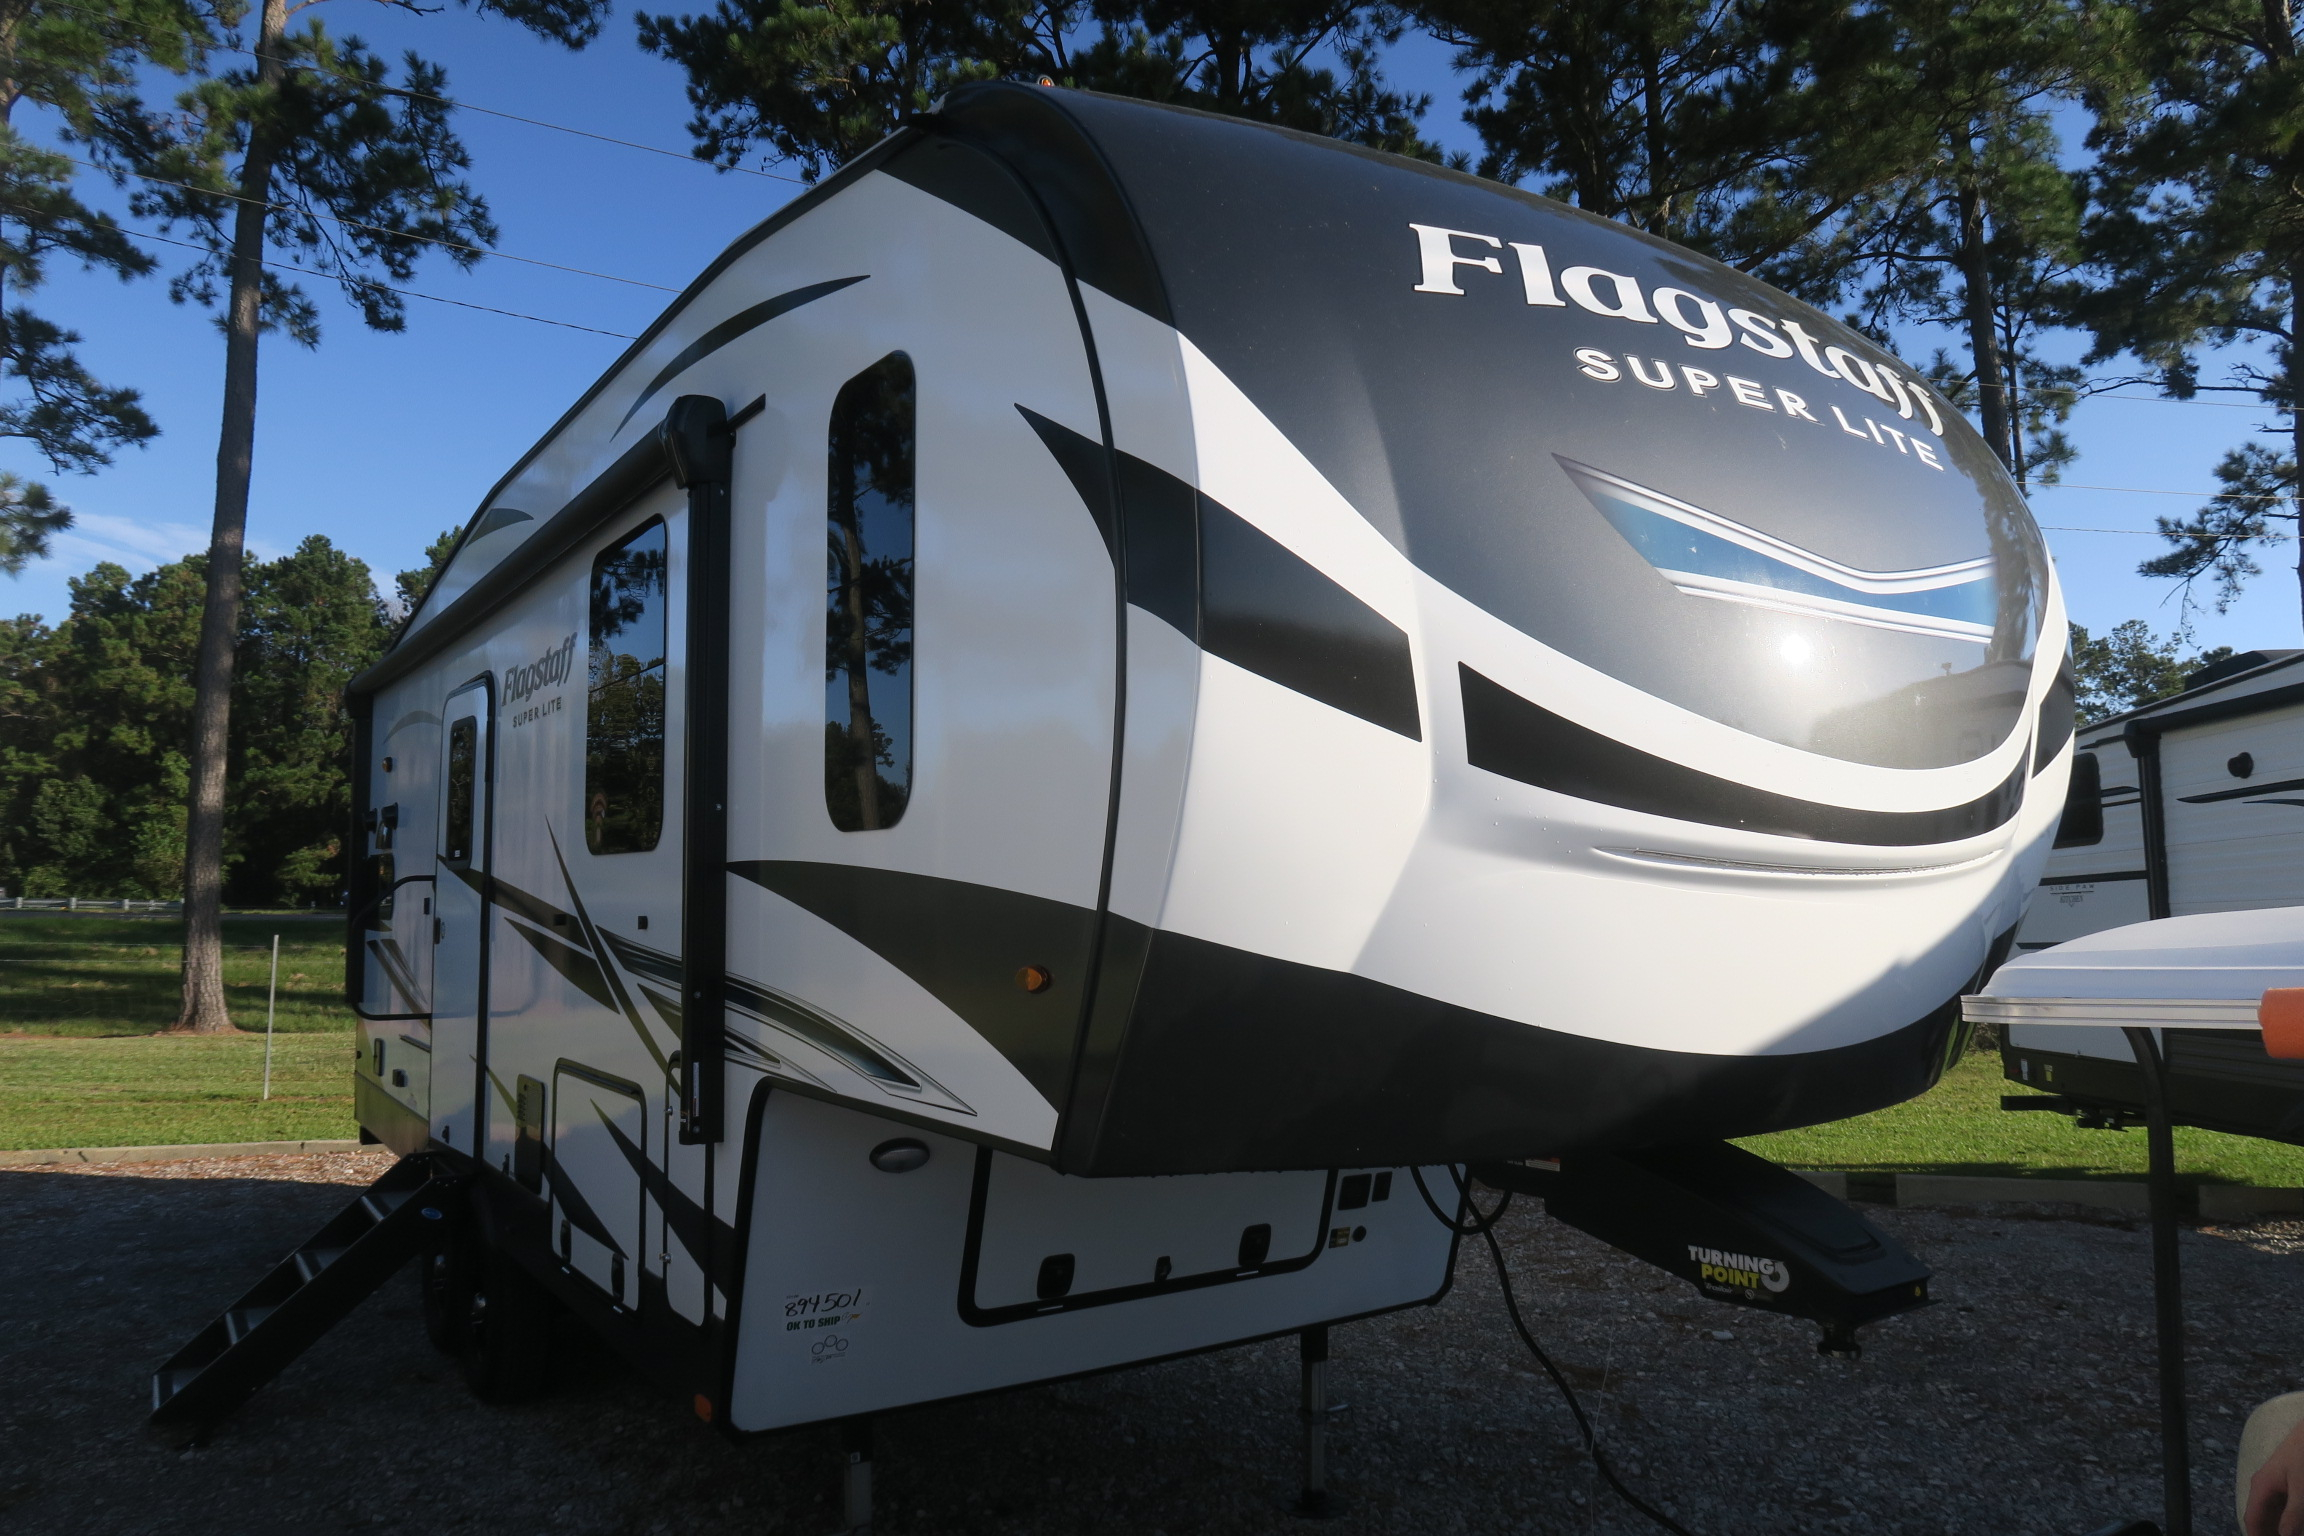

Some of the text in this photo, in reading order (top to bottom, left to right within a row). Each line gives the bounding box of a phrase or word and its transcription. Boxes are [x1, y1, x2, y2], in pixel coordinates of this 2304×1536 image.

[1408, 222, 1945, 437] Flagstaff
[1573, 347, 1945, 472] SUPER LITE
[501, 631, 578, 707] Flagstaff
[512, 696, 562, 729] SUPER LITE
[1687, 1244, 1775, 1275] TURNING
[1701, 1263, 1760, 1289] POINT
[784, 1288, 862, 1317] 894501
[786, 1315, 841, 1331] OK TO SHIP
